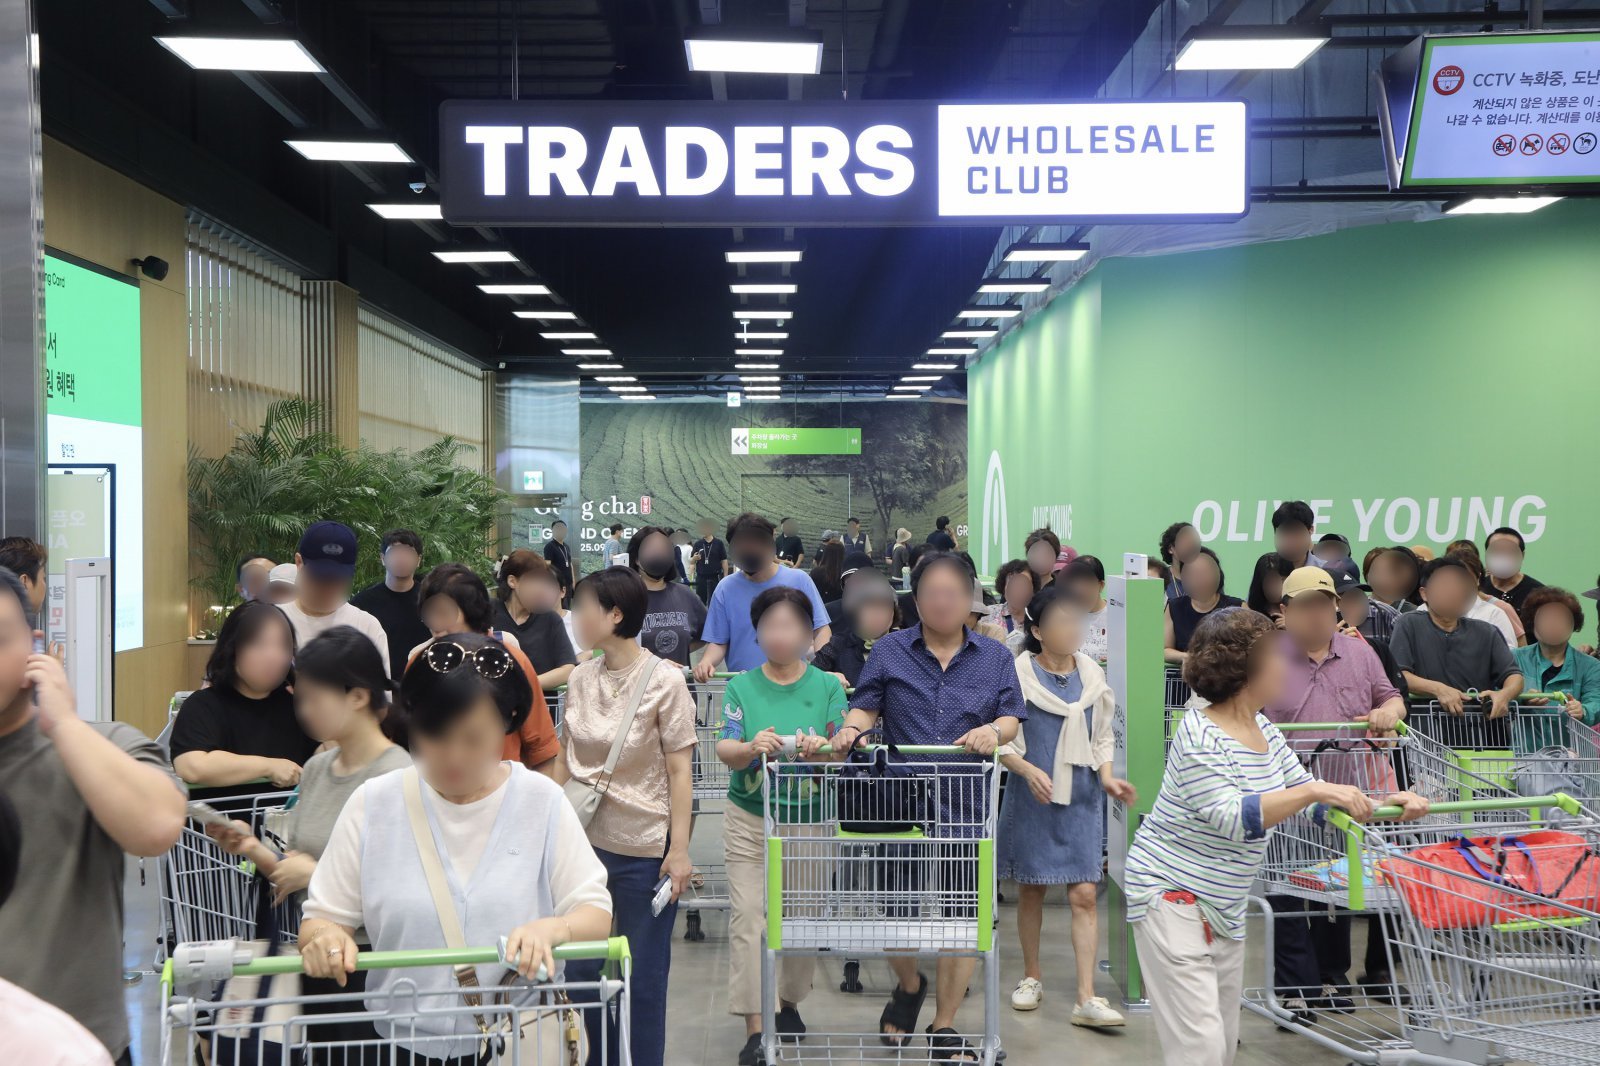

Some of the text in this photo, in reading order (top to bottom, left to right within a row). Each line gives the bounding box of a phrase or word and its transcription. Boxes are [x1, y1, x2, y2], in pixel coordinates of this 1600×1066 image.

[1473, 72, 1515, 87] CCTV
[1519, 71, 1567, 87] 녹화중,
[1472, 97, 1517, 110] 계산되지
[1520, 97, 1543, 110] 않은
[1545, 96, 1579, 109] 상품은
[1583, 95, 1594, 108] 이
[1446, 114, 1469, 126] 나갈
[1472, 115, 1483, 126] 수
[1486, 113, 1533, 126] 없습니다.
[1536, 112, 1581, 125] 계산대를
[966, 124, 1216, 155] WHOLESALE
[465, 124, 915, 197] TRADERS
[966, 165, 1069, 194] CLUB
[56, 371, 75, 403] 혜택
[599, 495, 638, 515] cha
[1192, 495, 1547, 543] OLIE YOUNG
